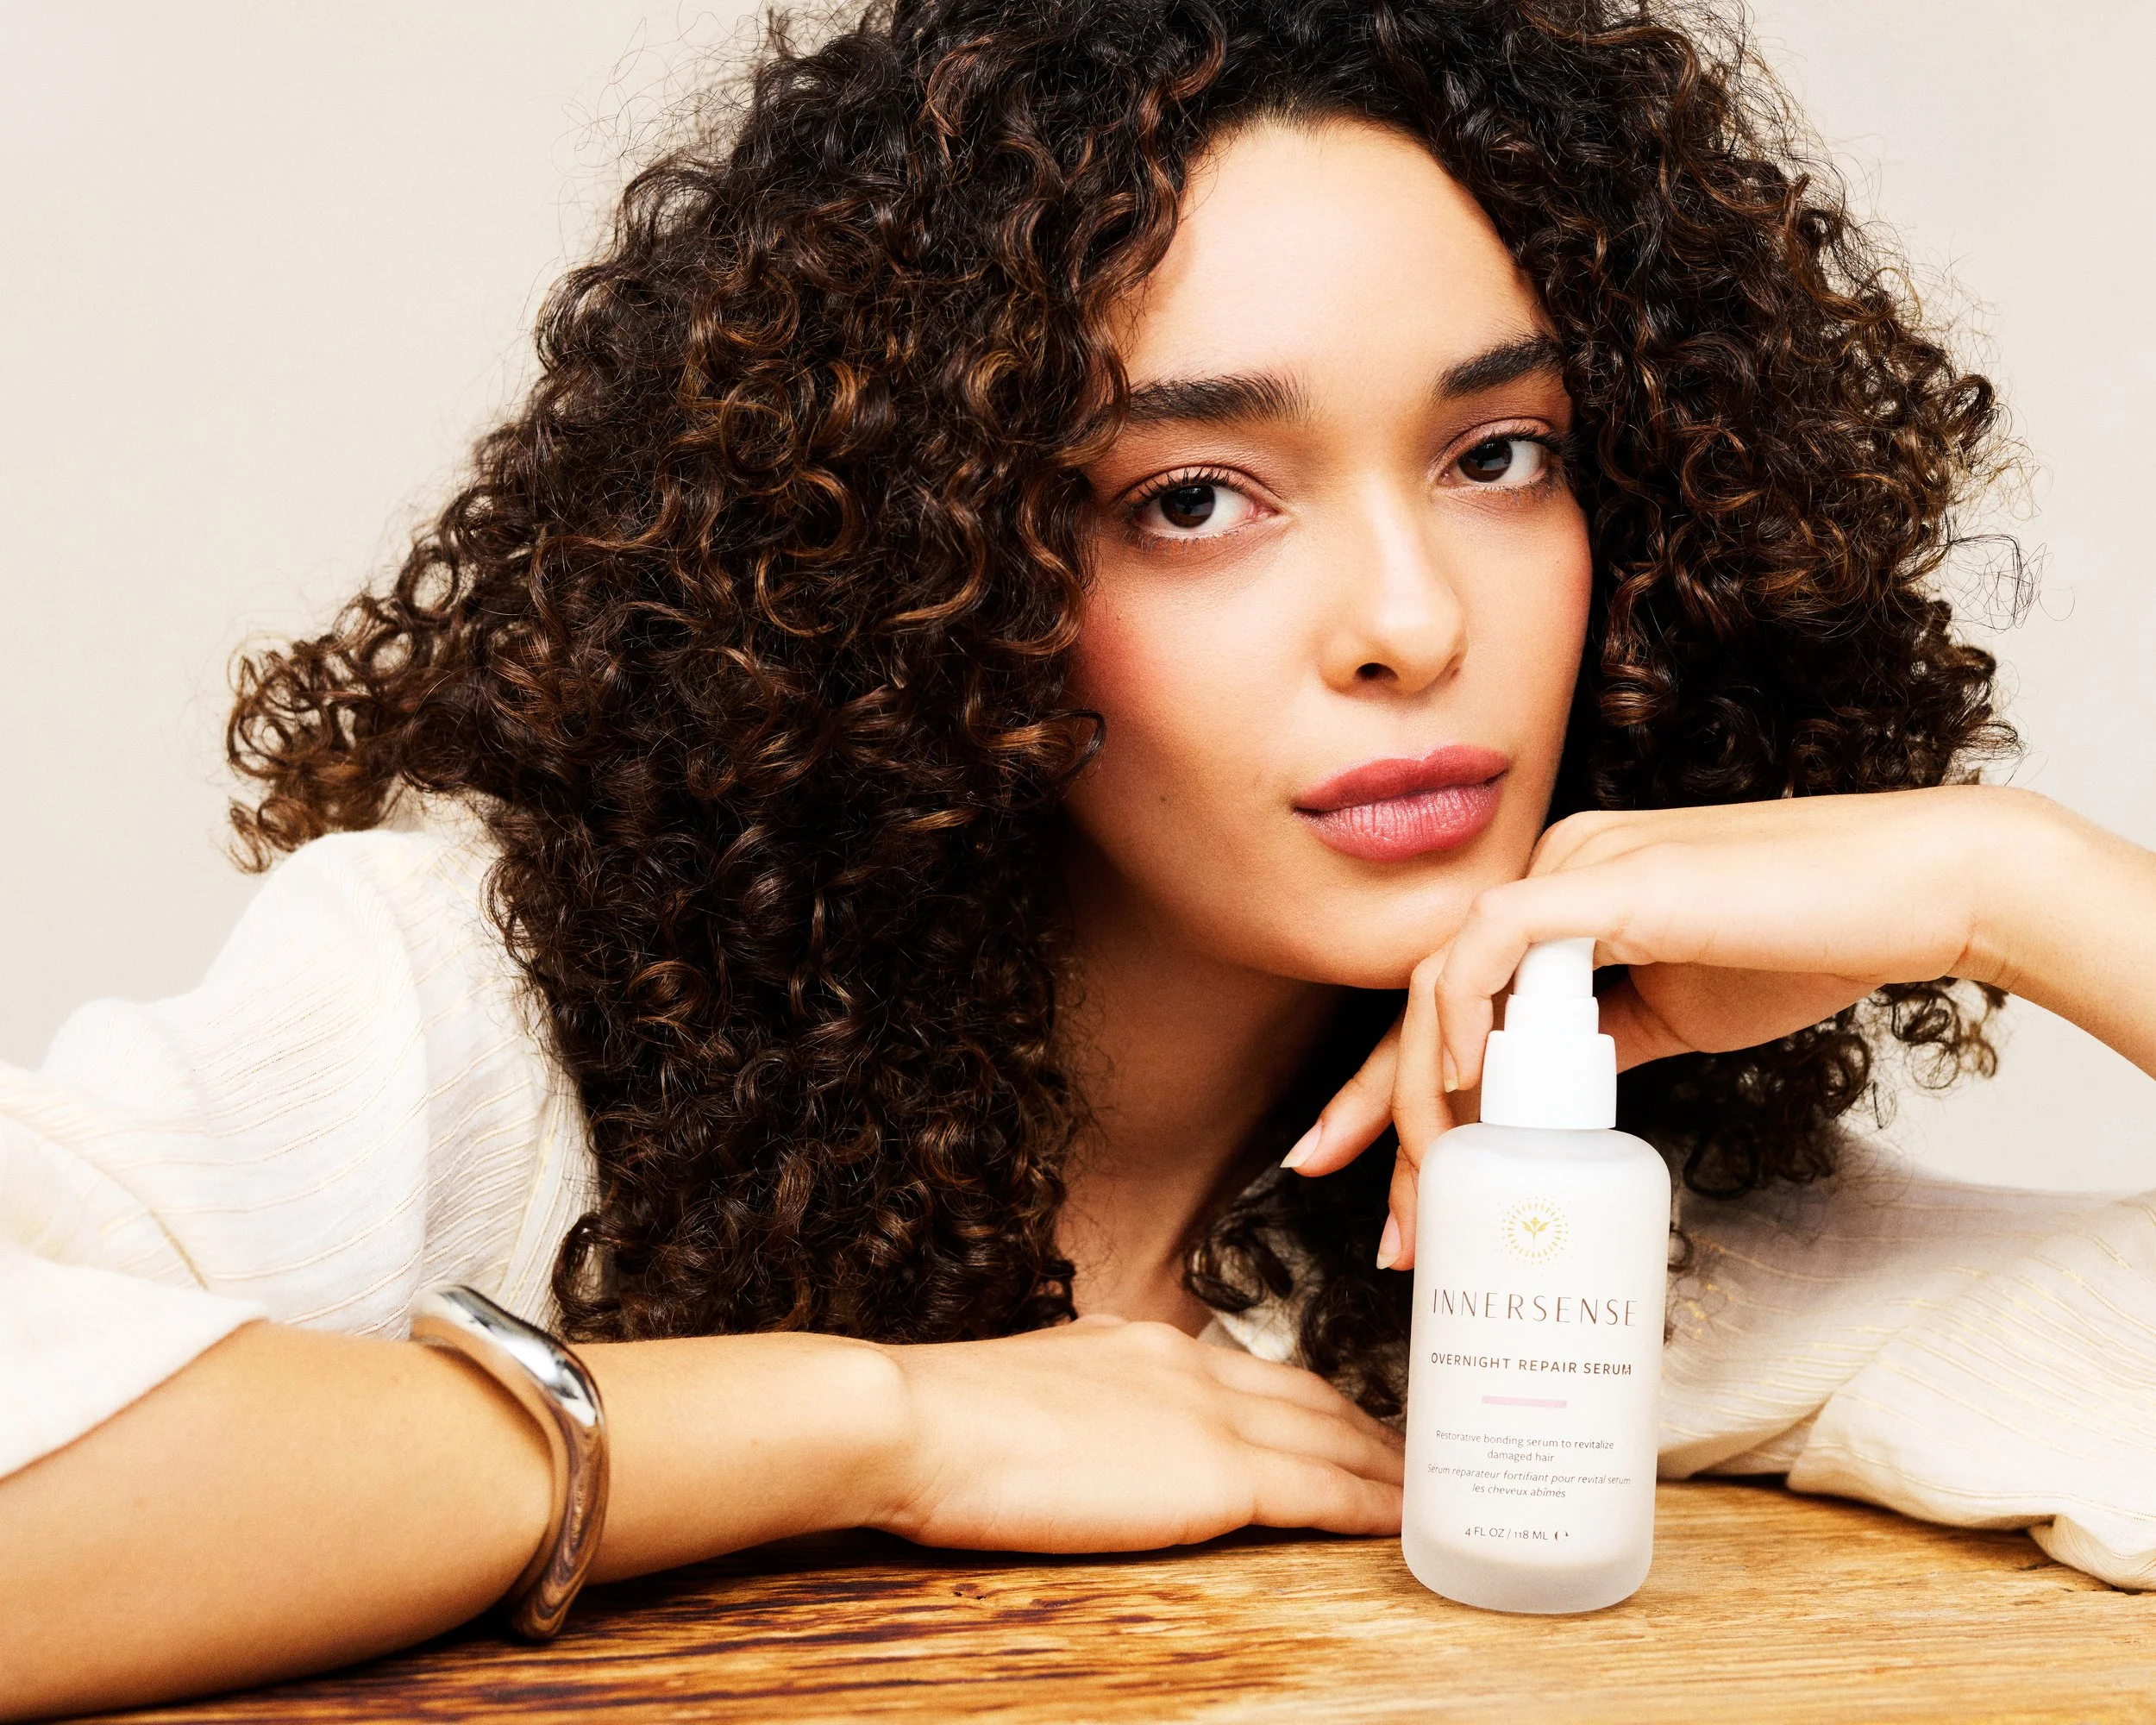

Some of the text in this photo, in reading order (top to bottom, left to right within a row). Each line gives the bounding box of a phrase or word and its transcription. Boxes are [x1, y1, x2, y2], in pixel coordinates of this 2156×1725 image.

[1432, 1289, 1638, 1327] INNERSENSE
[1431, 1352, 1632, 1375] OVERNIGHT REPAIR SERUM
[1436, 1430, 1614, 1450] Restorative bonding serum to revitalize
[1487, 1450, 1555, 1463] damaged hair
[1503, 1471, 1549, 1482] fortifiant
[1551, 1474, 1576, 1484] pour
[1577, 1474, 1607, 1484] revital
[1472, 1484, 1485, 1493] les
[1488, 1485, 1527, 1496] cheveux
[1464, 1527, 1471, 1537] 4
[1474, 1527, 1486, 1536] FL
[1489, 1527, 1505, 1538] OZ
[1514, 1529, 1529, 1540] 118
[1532, 1531, 1549, 1540] ML
